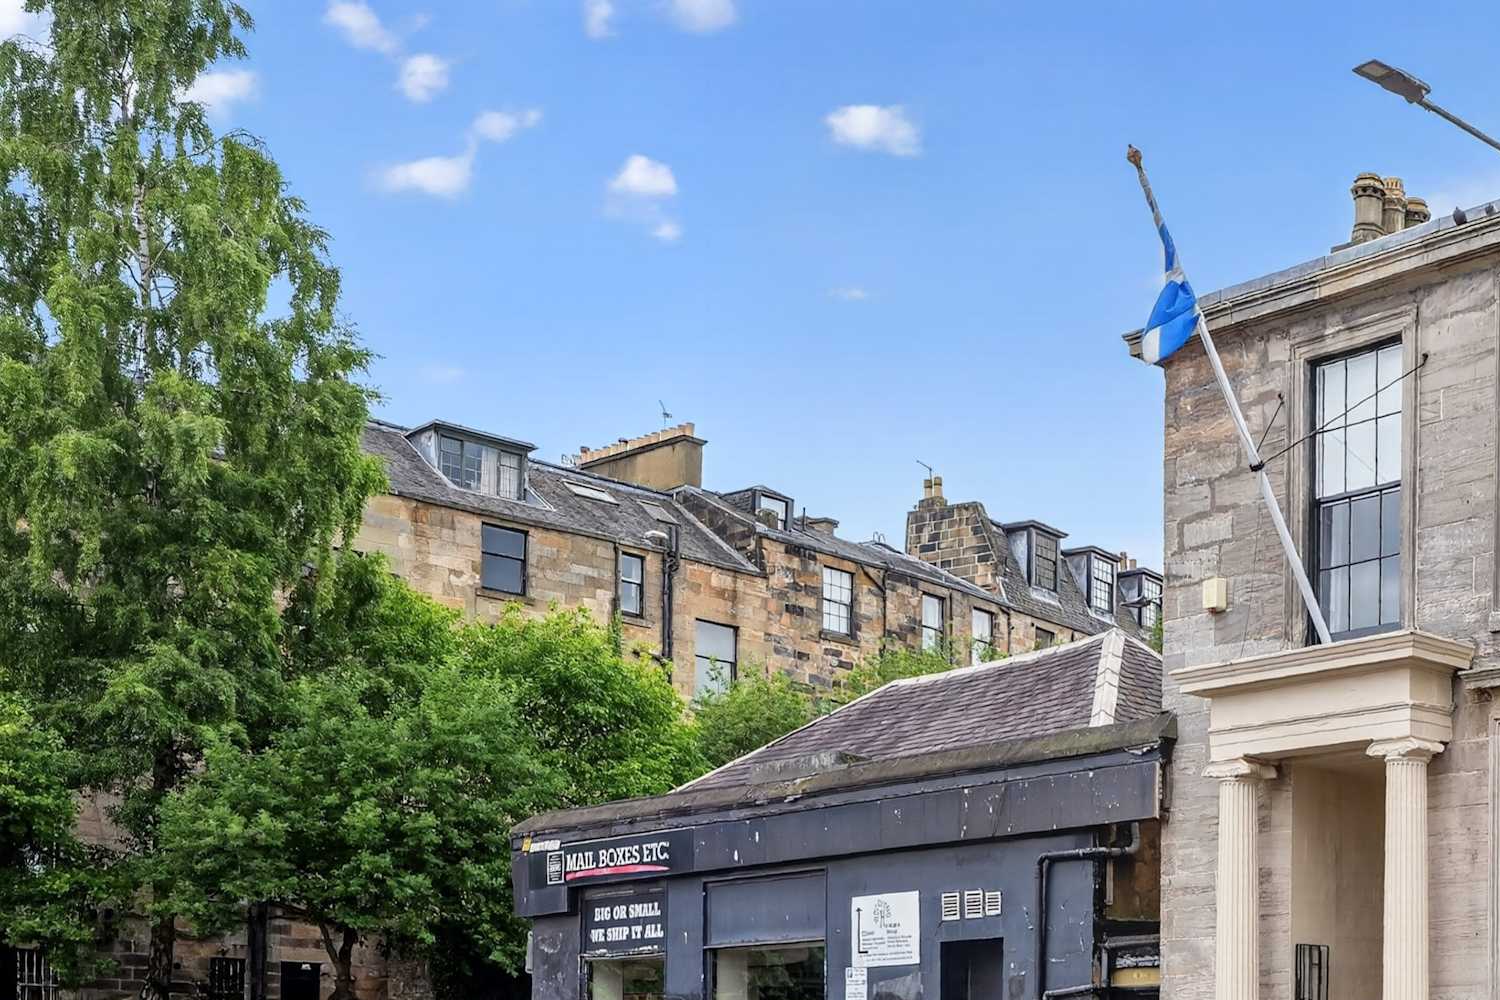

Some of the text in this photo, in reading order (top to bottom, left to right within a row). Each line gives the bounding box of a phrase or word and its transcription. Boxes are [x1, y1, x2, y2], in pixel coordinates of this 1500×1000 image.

[566, 852, 596, 872] MAIL
[599, 844, 640, 868] BOXES
[594, 902, 661, 921] BIG OR SMALL
[590, 923, 663, 942] WE SHIP IT ALL
